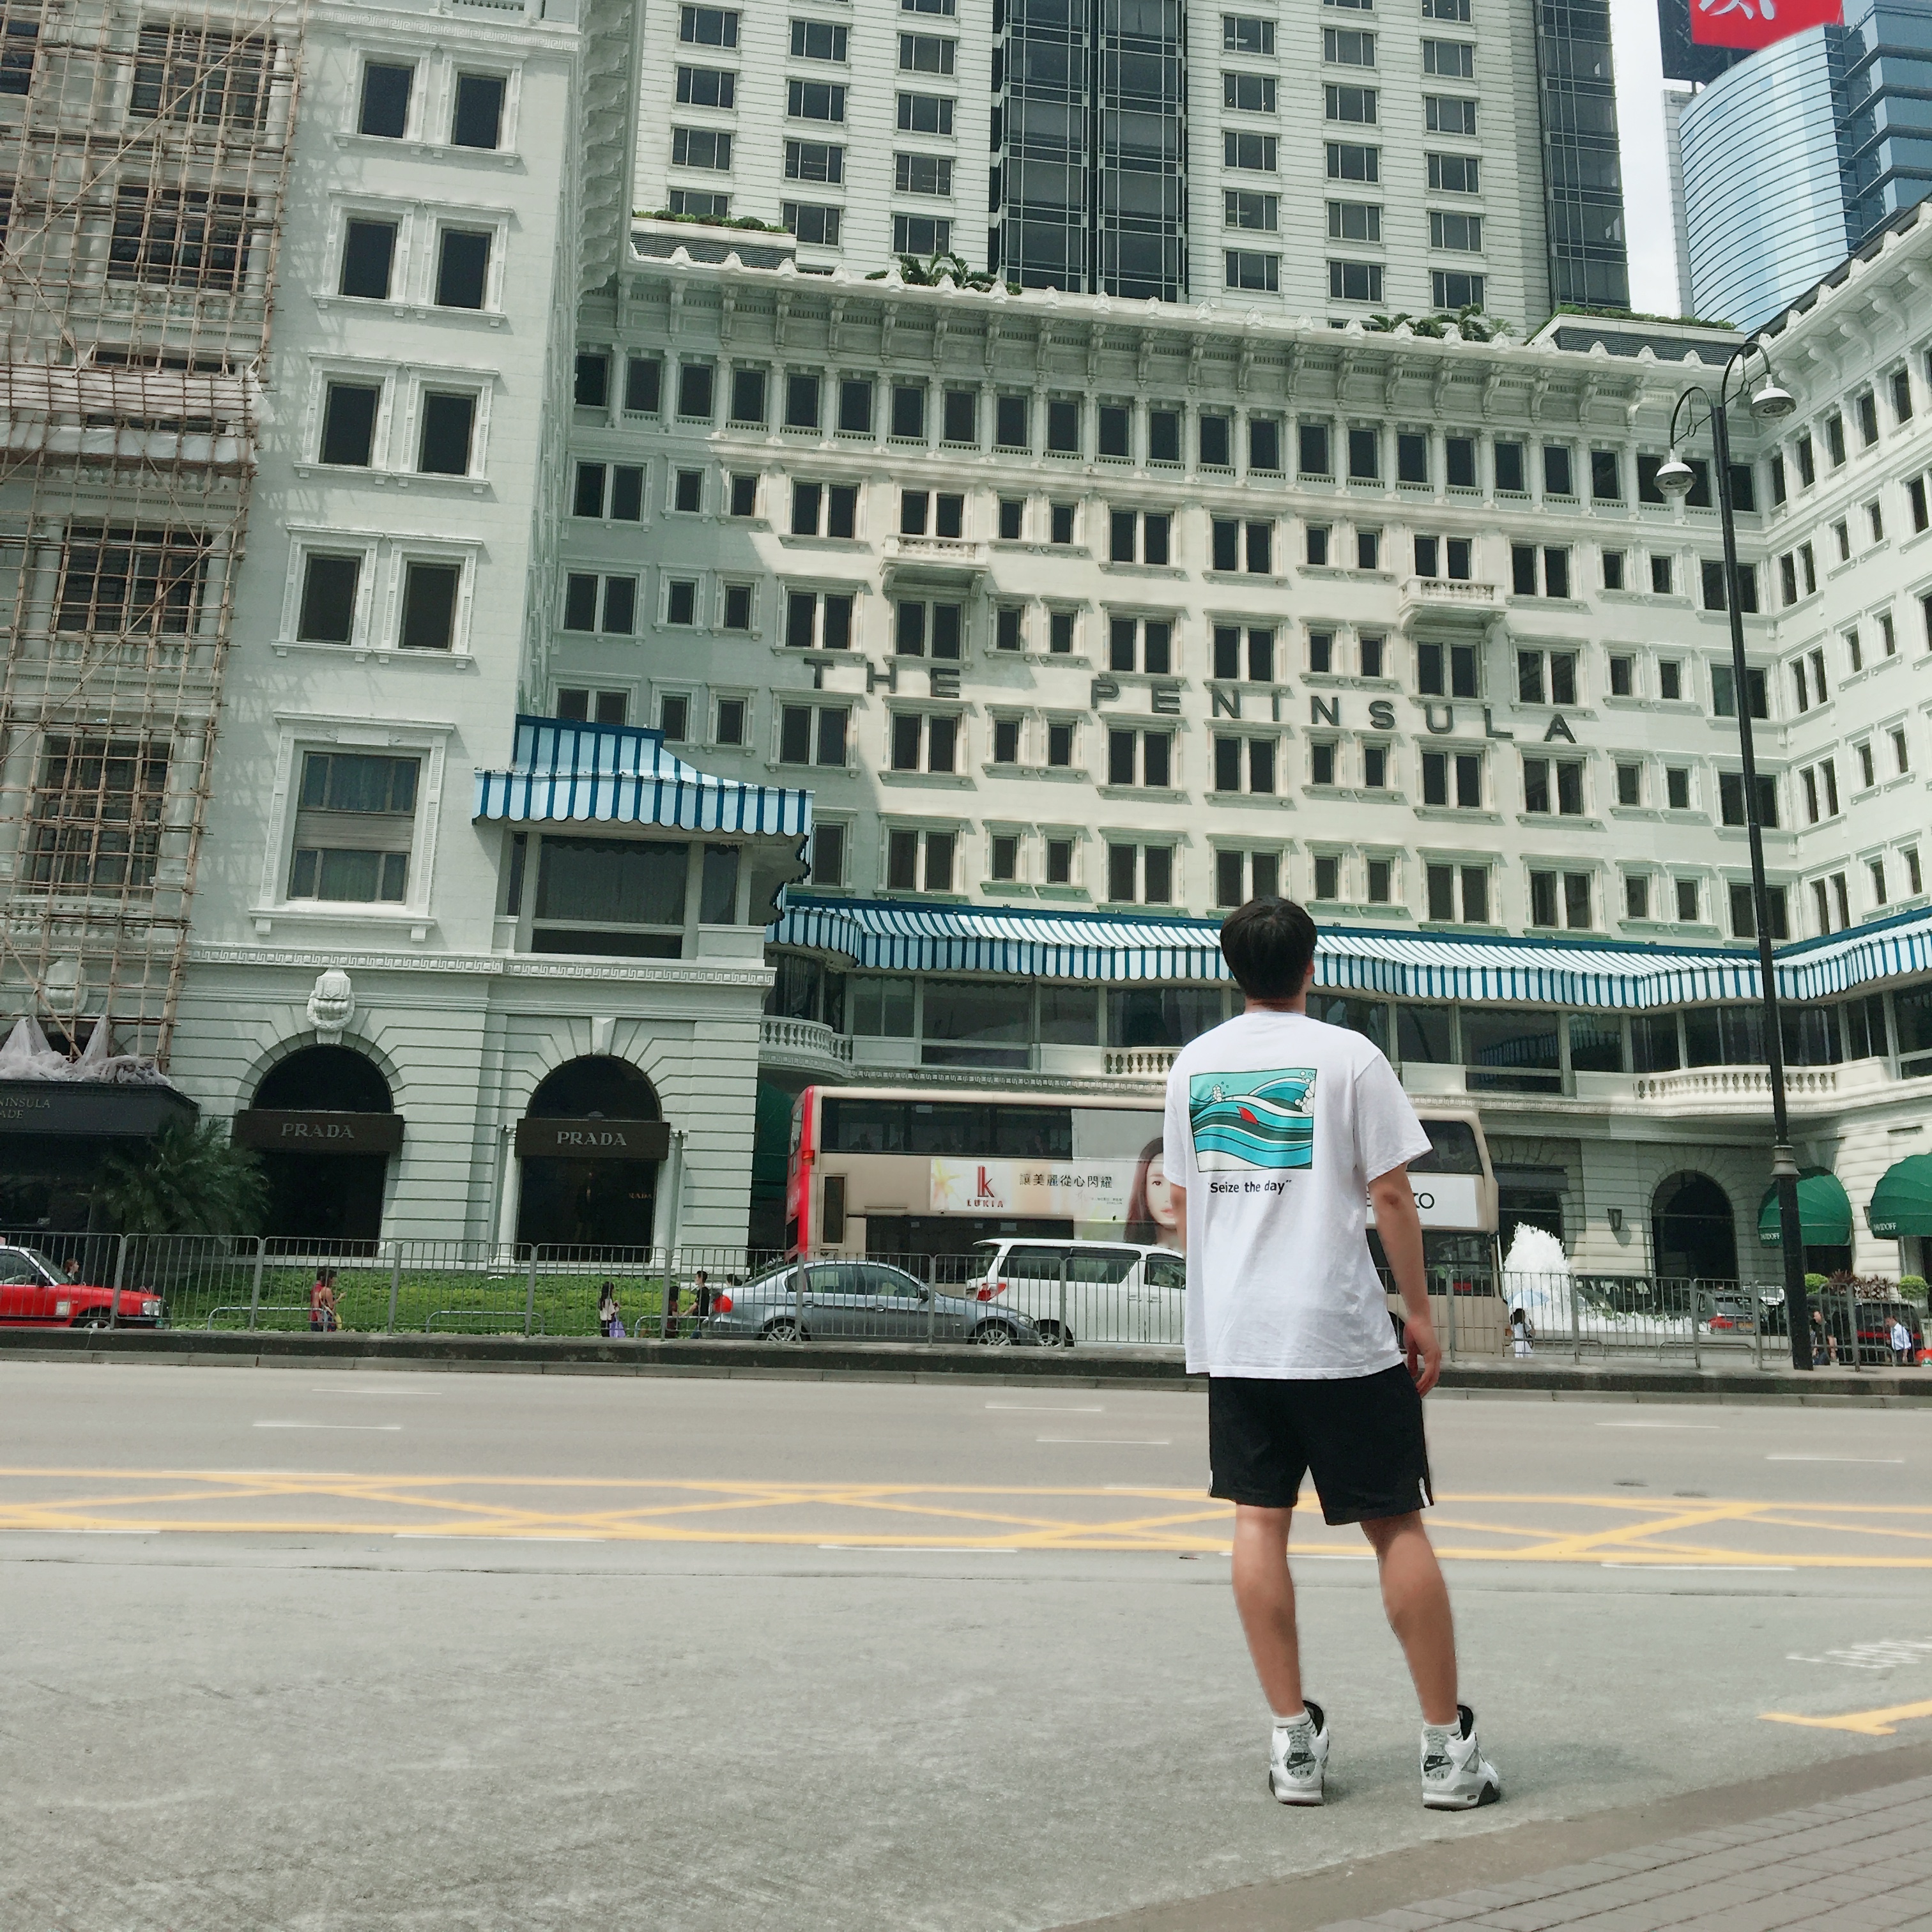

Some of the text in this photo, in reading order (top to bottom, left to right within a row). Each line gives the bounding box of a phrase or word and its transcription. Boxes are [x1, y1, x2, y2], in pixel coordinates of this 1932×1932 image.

[804, 657, 1577, 744] THE PENINSULA
[280, 1123, 355, 1138] PRADA
[556, 1131, 627, 1146] PRADA
[1244, 1181, 1261, 1192] the
[967, 1199, 1003, 1208] LUKIA
